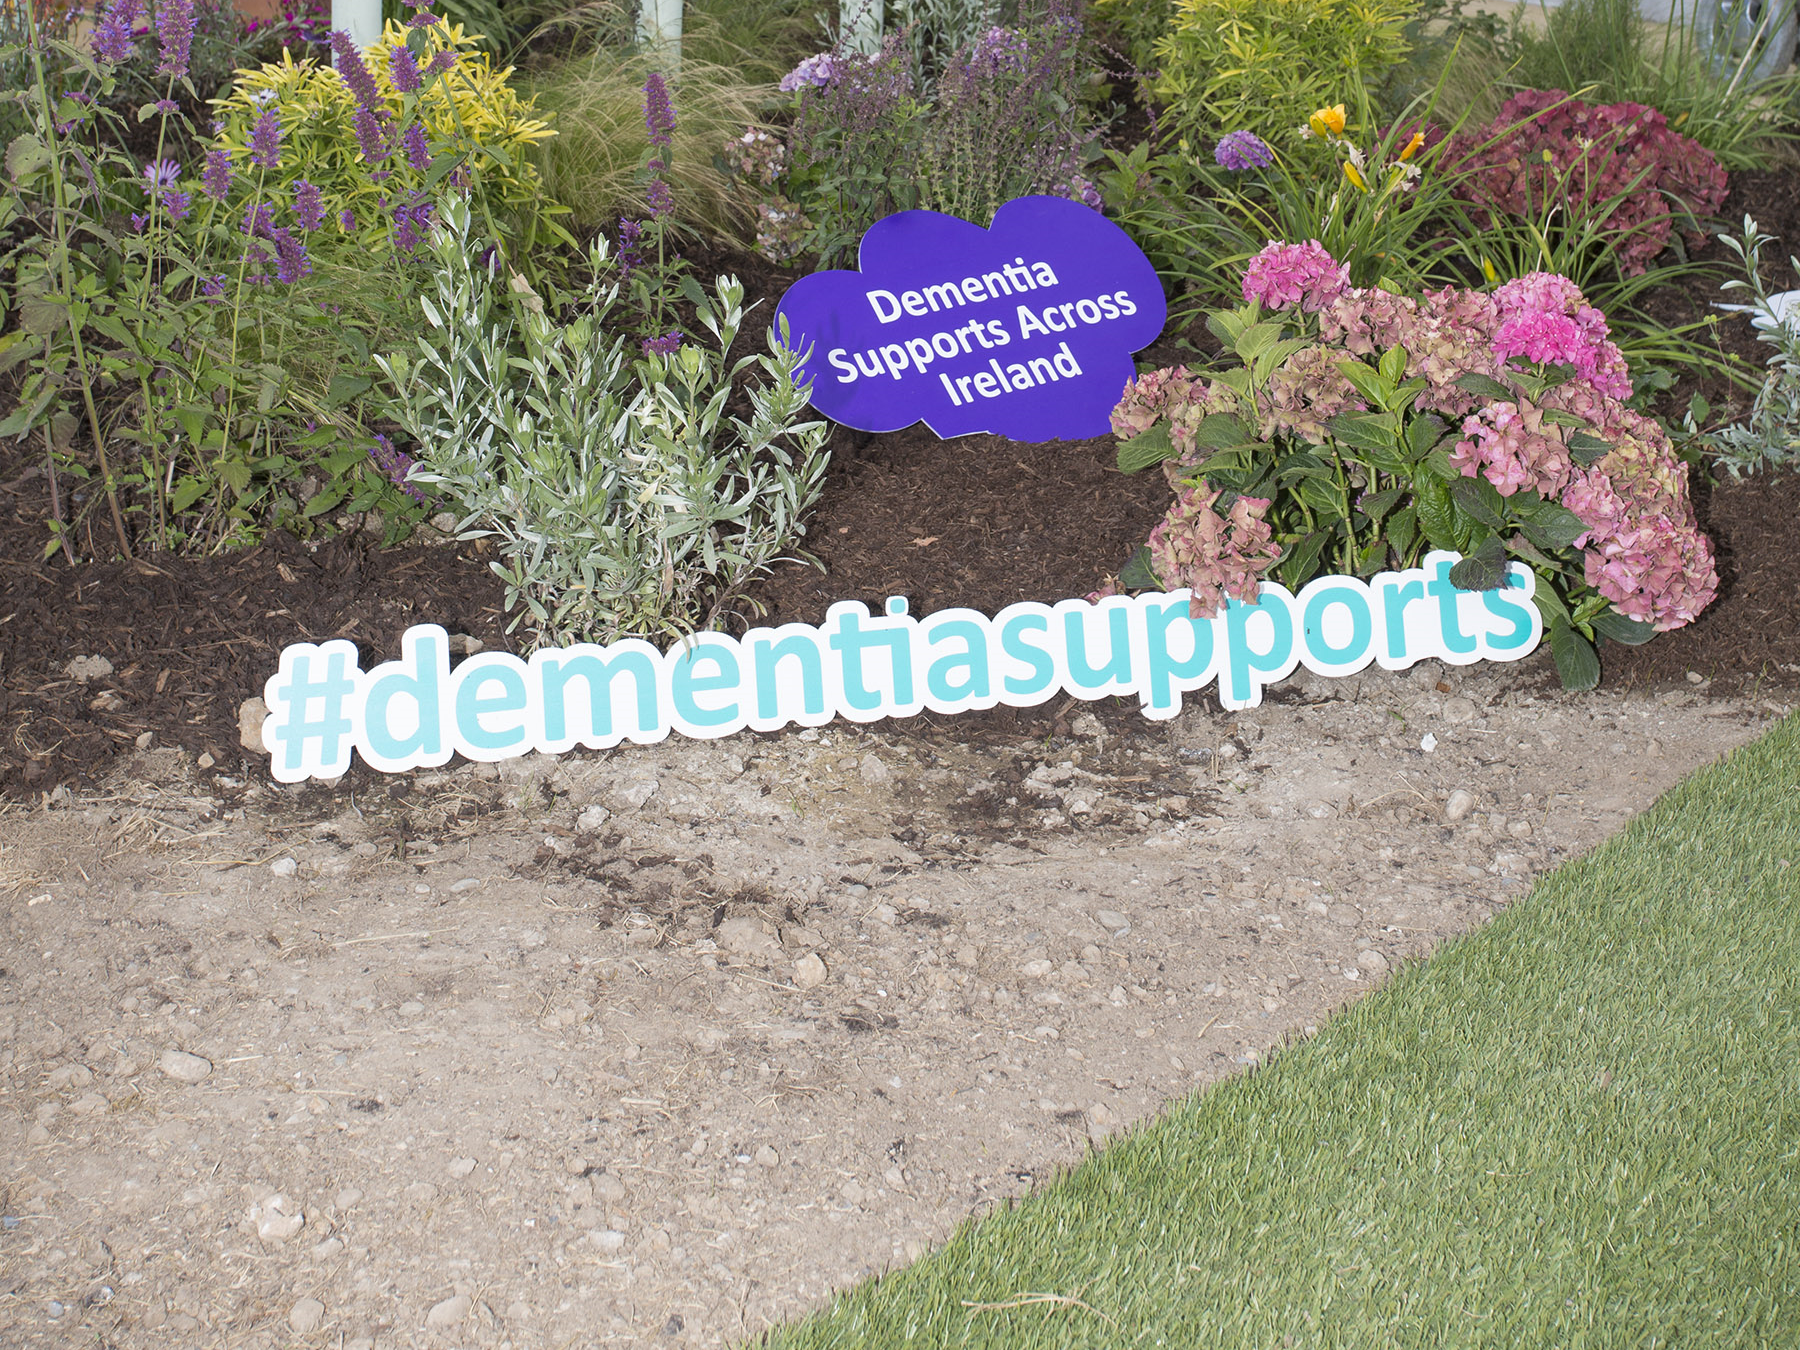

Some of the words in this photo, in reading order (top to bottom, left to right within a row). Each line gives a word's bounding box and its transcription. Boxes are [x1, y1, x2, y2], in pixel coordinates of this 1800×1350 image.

[865, 256, 1059, 325] Dementia
[826, 318, 1011, 385] Supports
[1016, 290, 1137, 340] Across
[938, 341, 1083, 407] Ireland
[274, 559, 1534, 771] #dementiasupports
